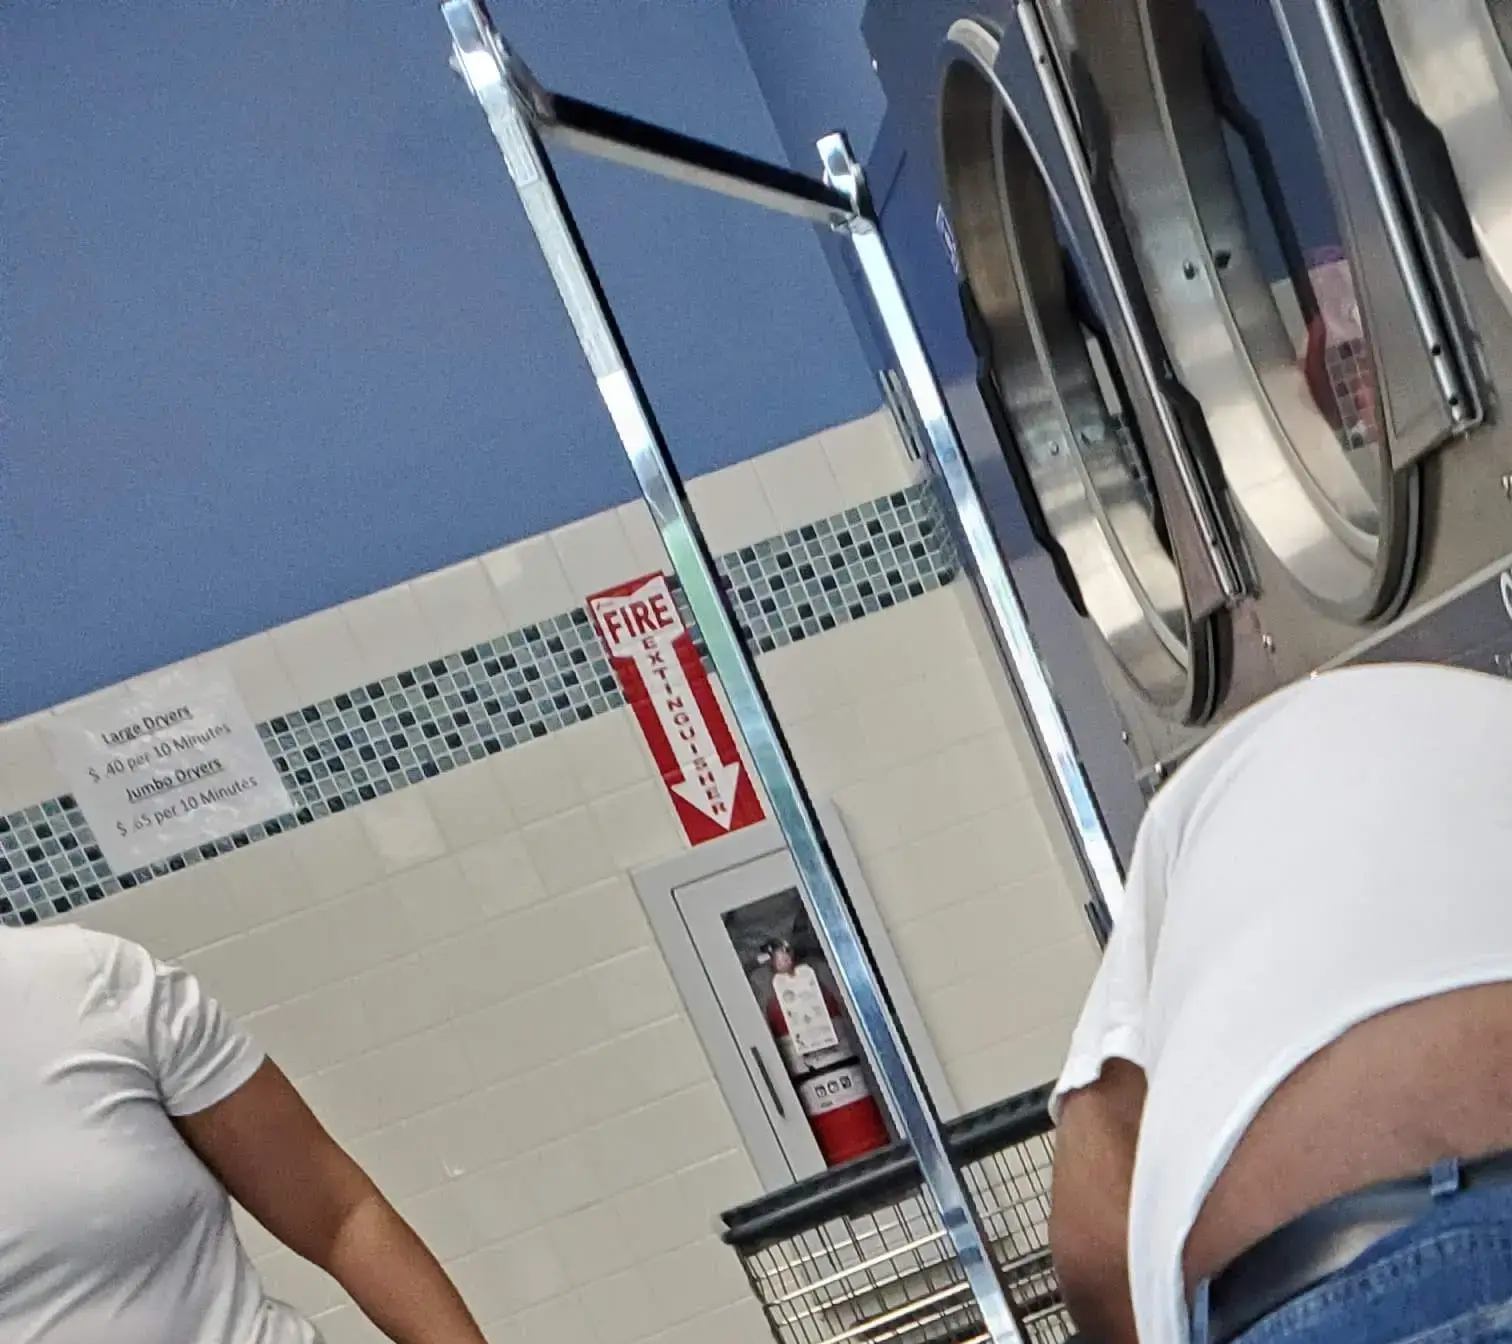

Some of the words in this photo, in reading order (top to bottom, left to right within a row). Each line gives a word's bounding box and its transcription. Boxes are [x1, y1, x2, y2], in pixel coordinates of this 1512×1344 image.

[602, 593, 674, 645] FIRE
[101, 722, 142, 746] Large
[141, 704, 194, 732] Dryers
[127, 750, 151, 773] per
[153, 741, 172, 759] 10
[172, 722, 232, 752] Minutes
[640, 634, 728, 816] EXTINGUISHER
[125, 774, 173, 803] Jumbo
[174, 757, 223, 783] Dryers
[154, 803, 178, 826] per
[180, 794, 199, 813] 10
[199, 775, 258, 806] Minutes
